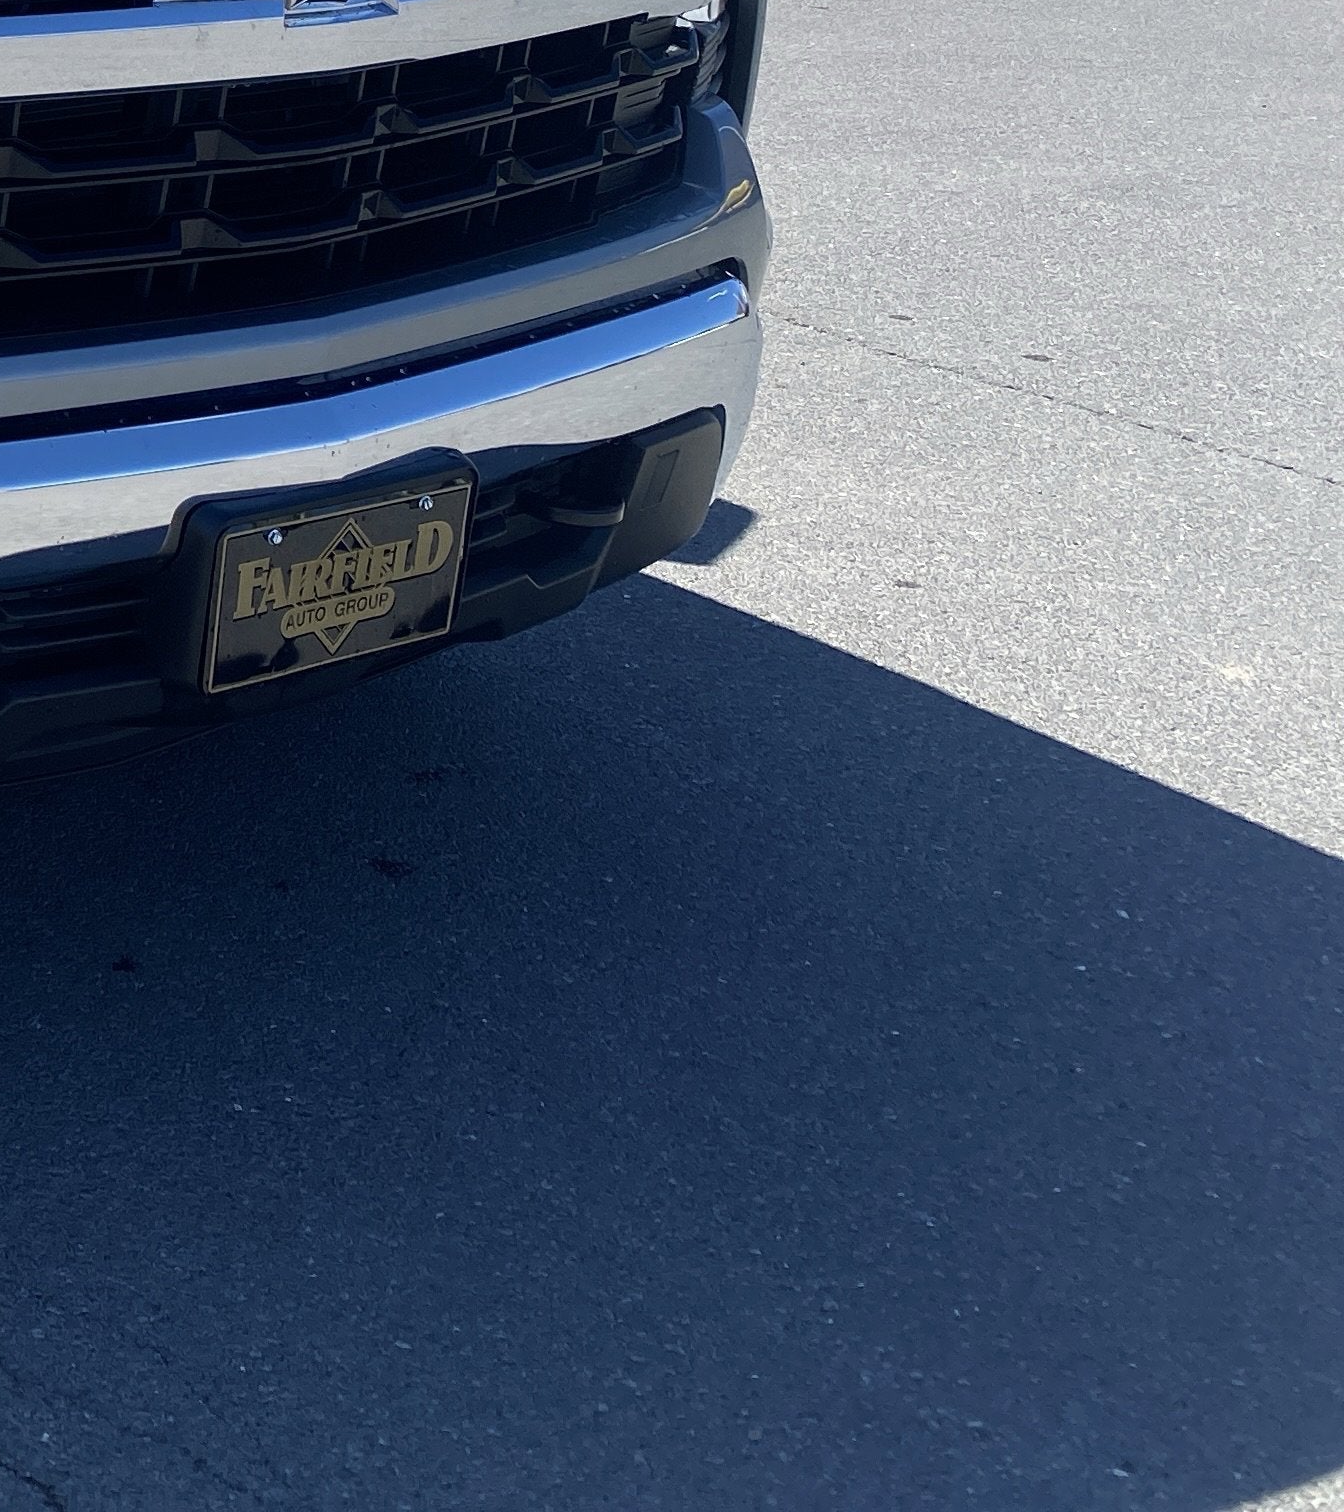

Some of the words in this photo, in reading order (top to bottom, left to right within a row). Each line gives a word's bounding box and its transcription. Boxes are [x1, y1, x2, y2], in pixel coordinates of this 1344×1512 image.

[233, 520, 454, 622] FAIRFIELD
[285, 606, 326, 632] AUTO
[334, 591, 390, 618] GROUP
